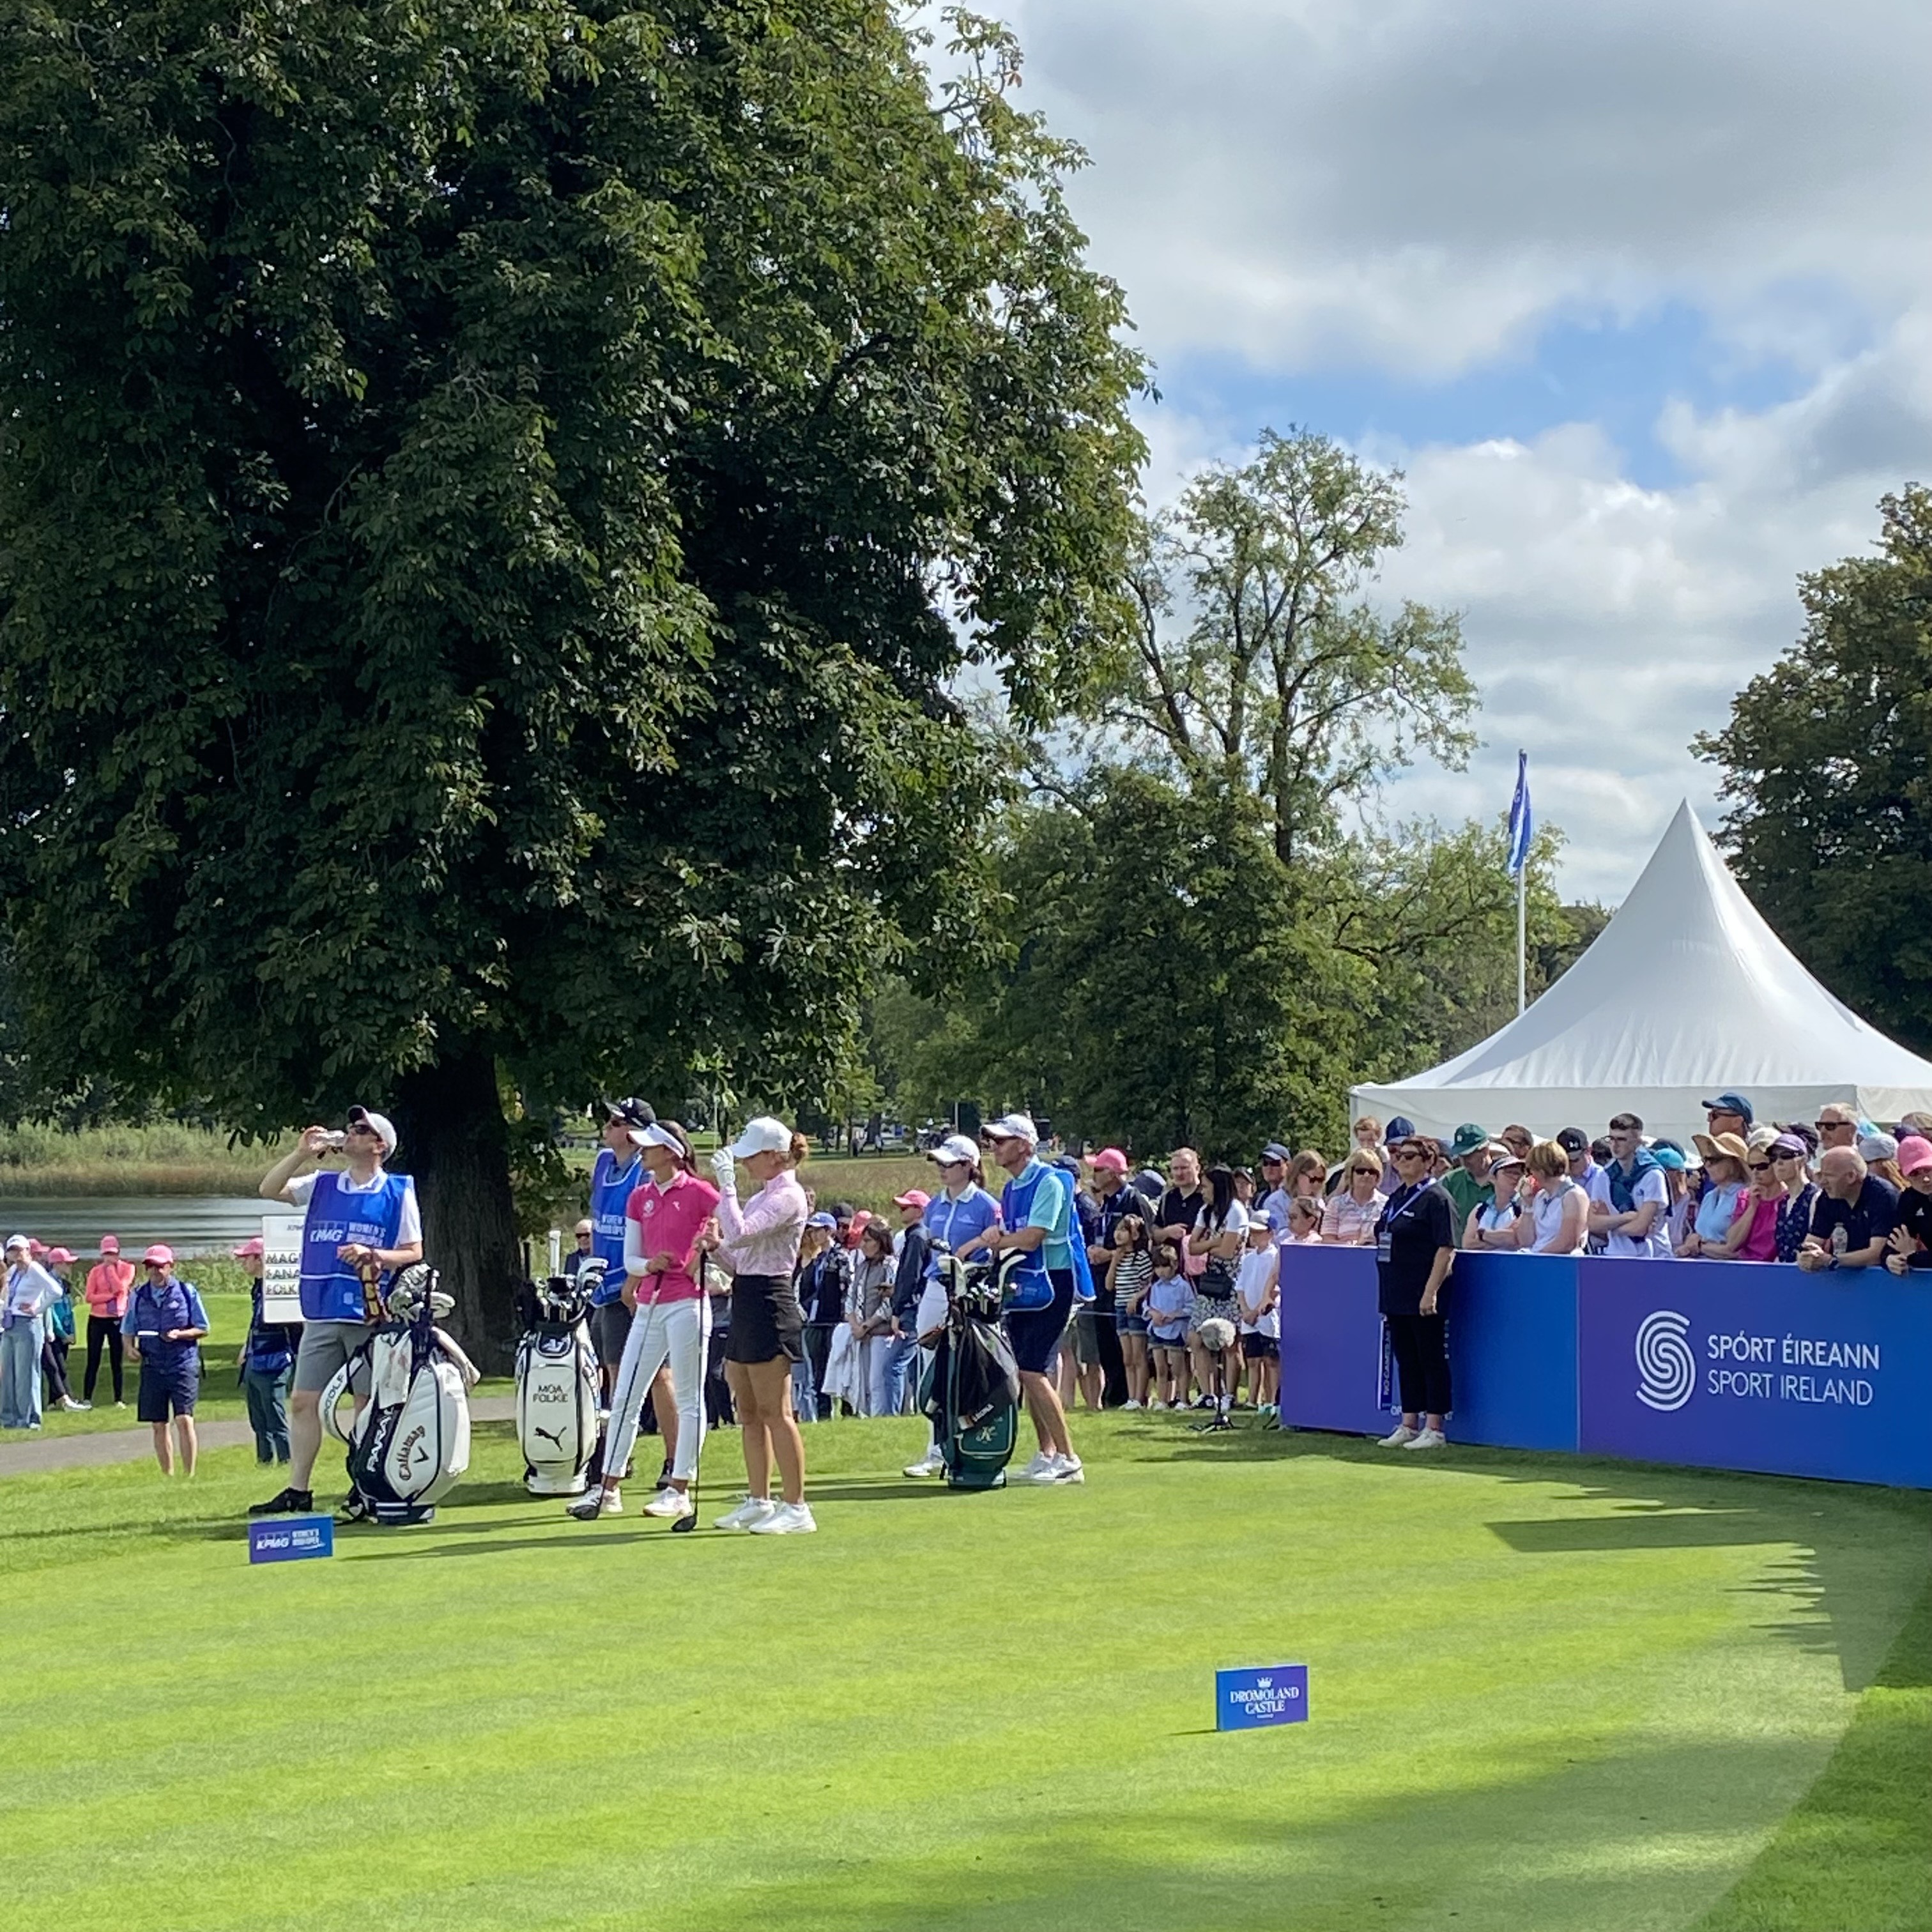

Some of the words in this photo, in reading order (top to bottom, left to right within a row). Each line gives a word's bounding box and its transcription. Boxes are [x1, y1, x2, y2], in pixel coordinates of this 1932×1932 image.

[266, 1252, 302, 1264] MAG
[266, 1268, 300, 1280] FANA
[266, 1283, 300, 1295] FOLK
[1708, 1330, 1775, 1362] SPÓRT
[1782, 1333, 1880, 1370] ÉIREANN
[538, 1384, 563, 1393] MOA
[1707, 1370, 1774, 1399] SPORT
[1780, 1375, 1873, 1406] IRELAND
[533, 1393, 569, 1402] FOLKE
[397, 1425, 425, 1480] Callaway
[256, 1538, 289, 1550] KPMG
[1230, 1687, 1300, 1704] DROMOLAND
[1245, 1699, 1285, 1714] CASTLE
